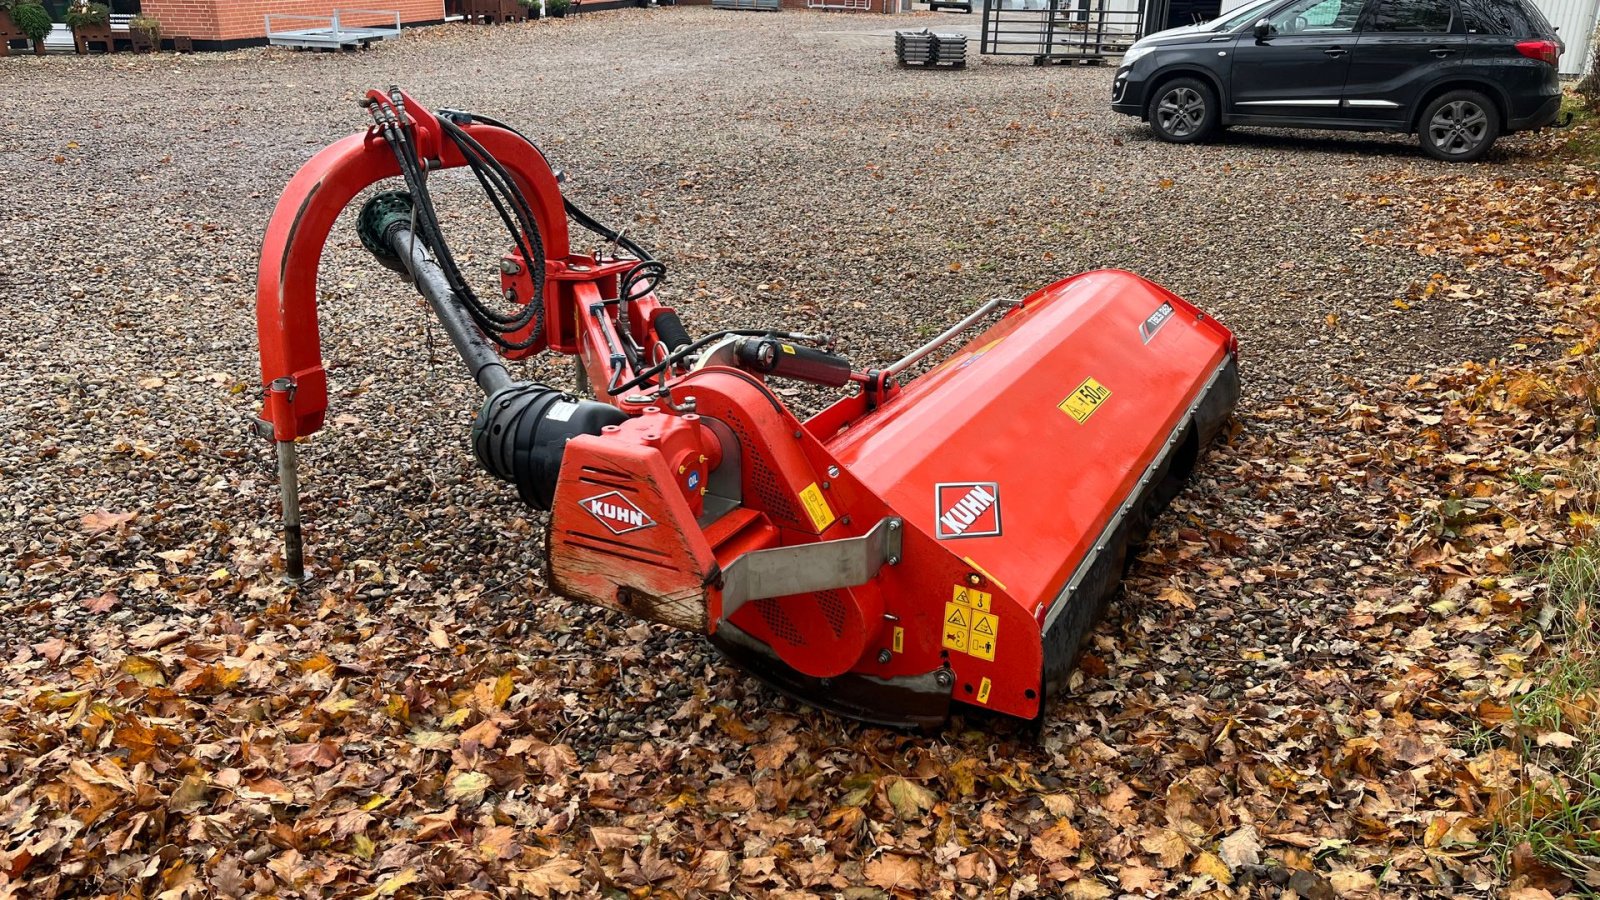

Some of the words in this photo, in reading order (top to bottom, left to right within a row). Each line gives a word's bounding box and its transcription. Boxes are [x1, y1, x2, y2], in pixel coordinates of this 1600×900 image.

[688, 474, 698, 488] OIL
[591, 499, 643, 526] KUHN
[940, 485, 996, 535] KUHN
